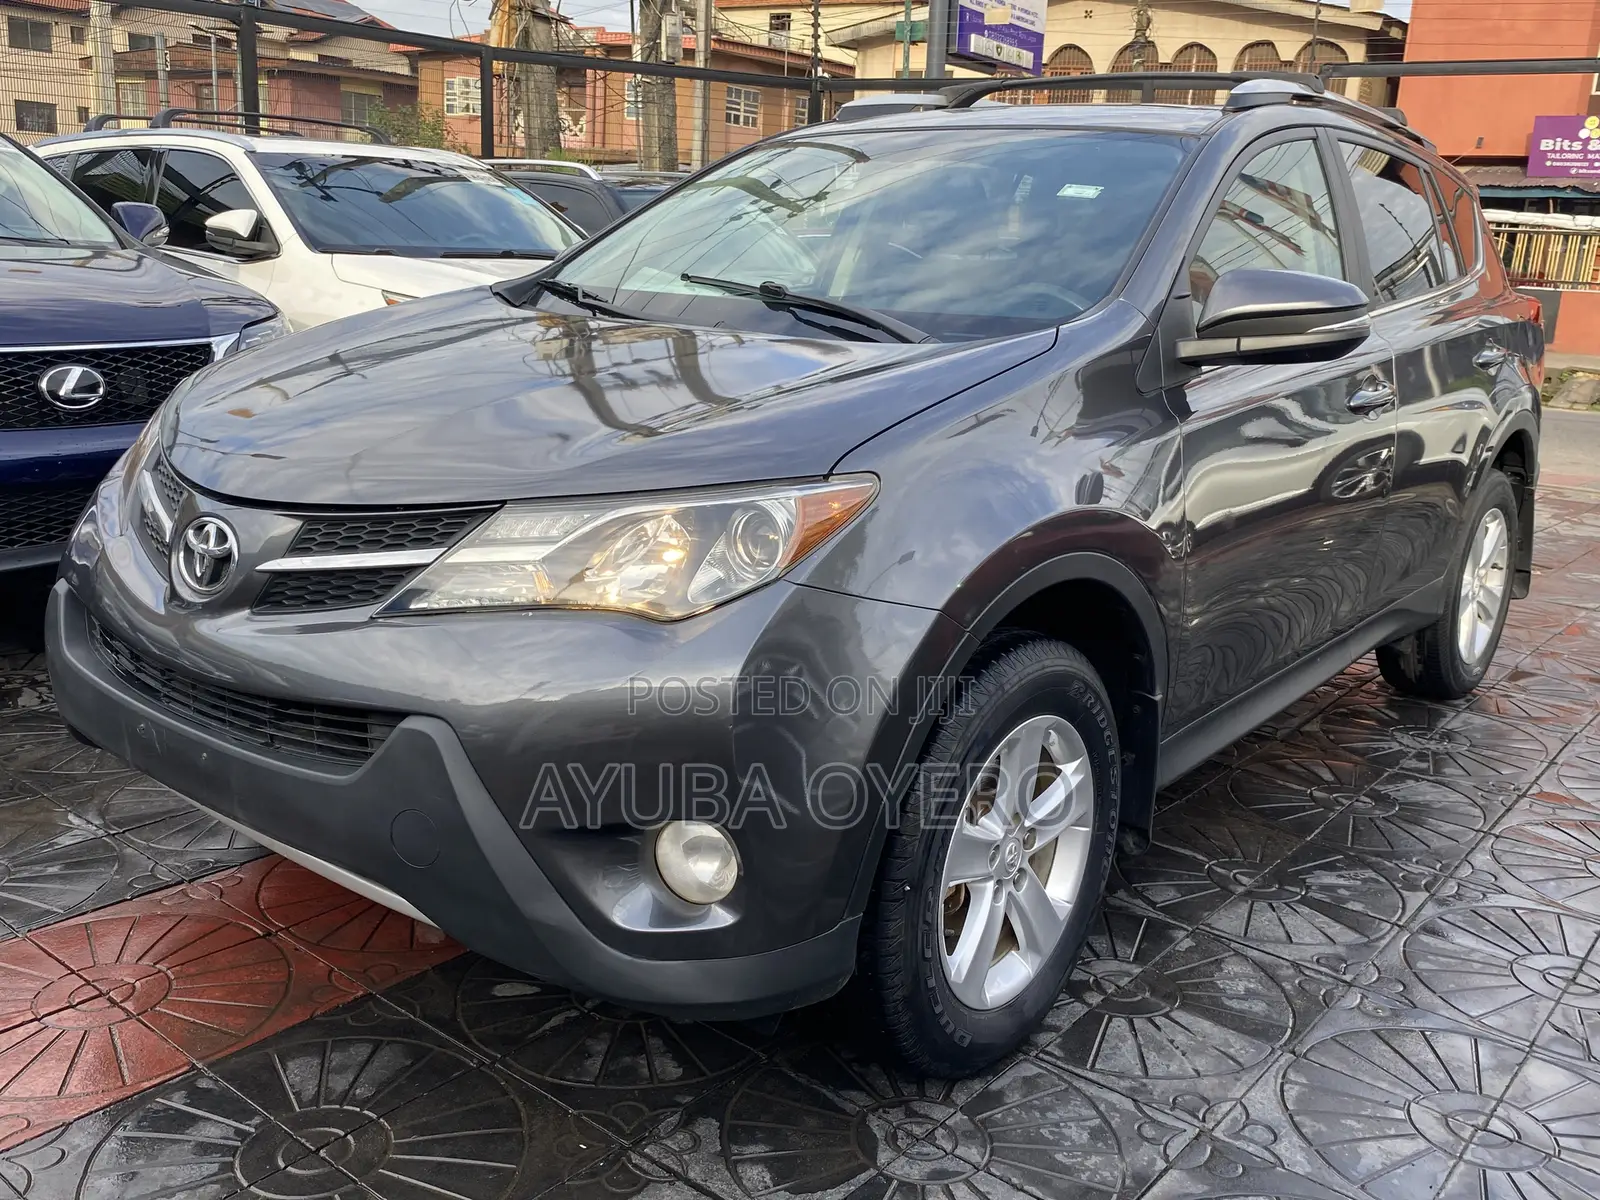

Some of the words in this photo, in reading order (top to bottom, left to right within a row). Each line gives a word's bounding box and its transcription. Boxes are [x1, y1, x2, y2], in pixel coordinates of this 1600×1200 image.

[1540, 138, 1583, 151] Bits
[1587, 139, 1600, 151] &
[1546, 152, 1584, 160] TAILORING
